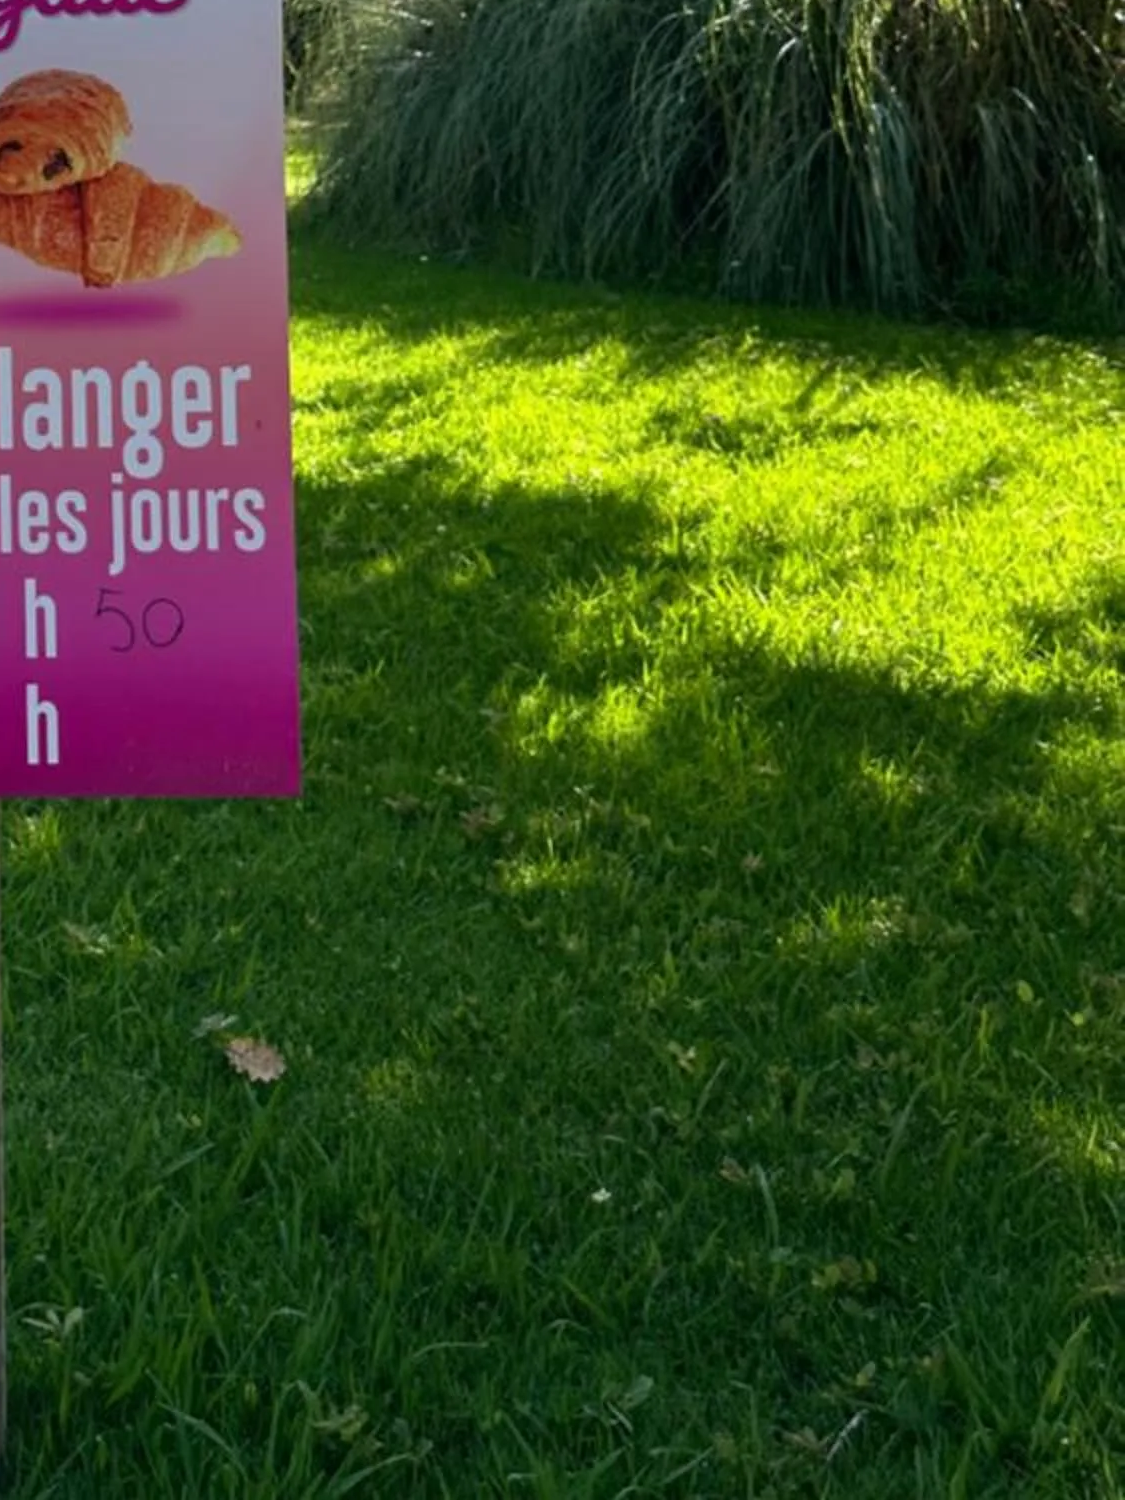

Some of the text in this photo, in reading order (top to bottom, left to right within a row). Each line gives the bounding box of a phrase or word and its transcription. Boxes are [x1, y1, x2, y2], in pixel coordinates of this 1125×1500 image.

[0, 475, 88, 554] les
[108, 473, 267, 575] jours
[24, 579, 57, 659] h
[95, 587, 185, 653] 50
[26, 684, 59, 765] h
